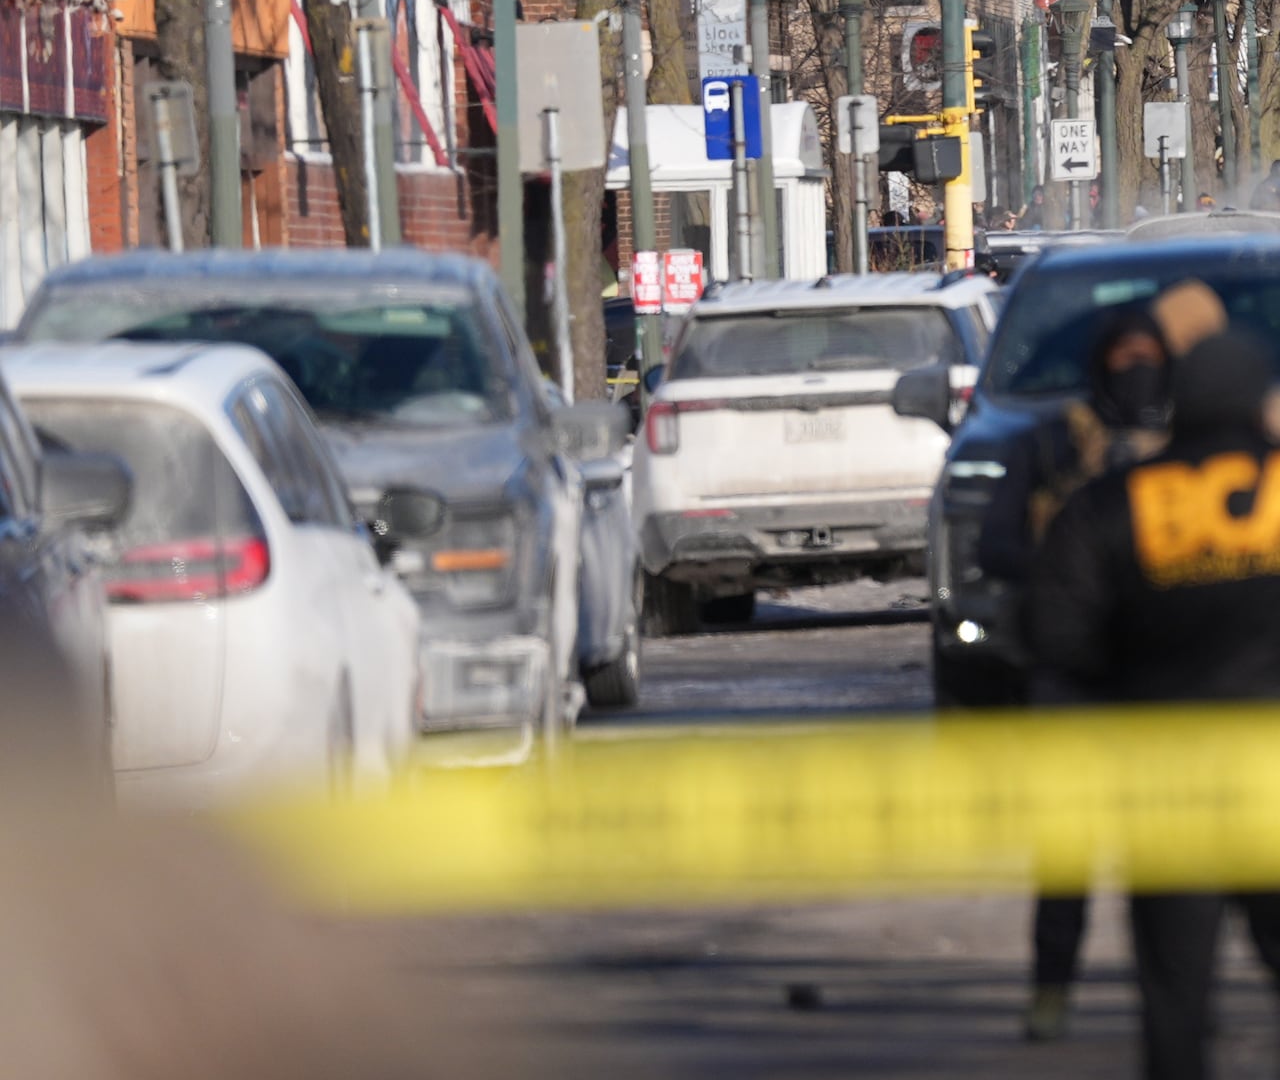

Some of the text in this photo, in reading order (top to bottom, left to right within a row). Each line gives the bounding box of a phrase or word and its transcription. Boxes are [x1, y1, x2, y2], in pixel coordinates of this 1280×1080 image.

[705, 42, 734, 53] shee
[1060, 125, 1089, 138] ONE
[1060, 140, 1089, 154] WAY
